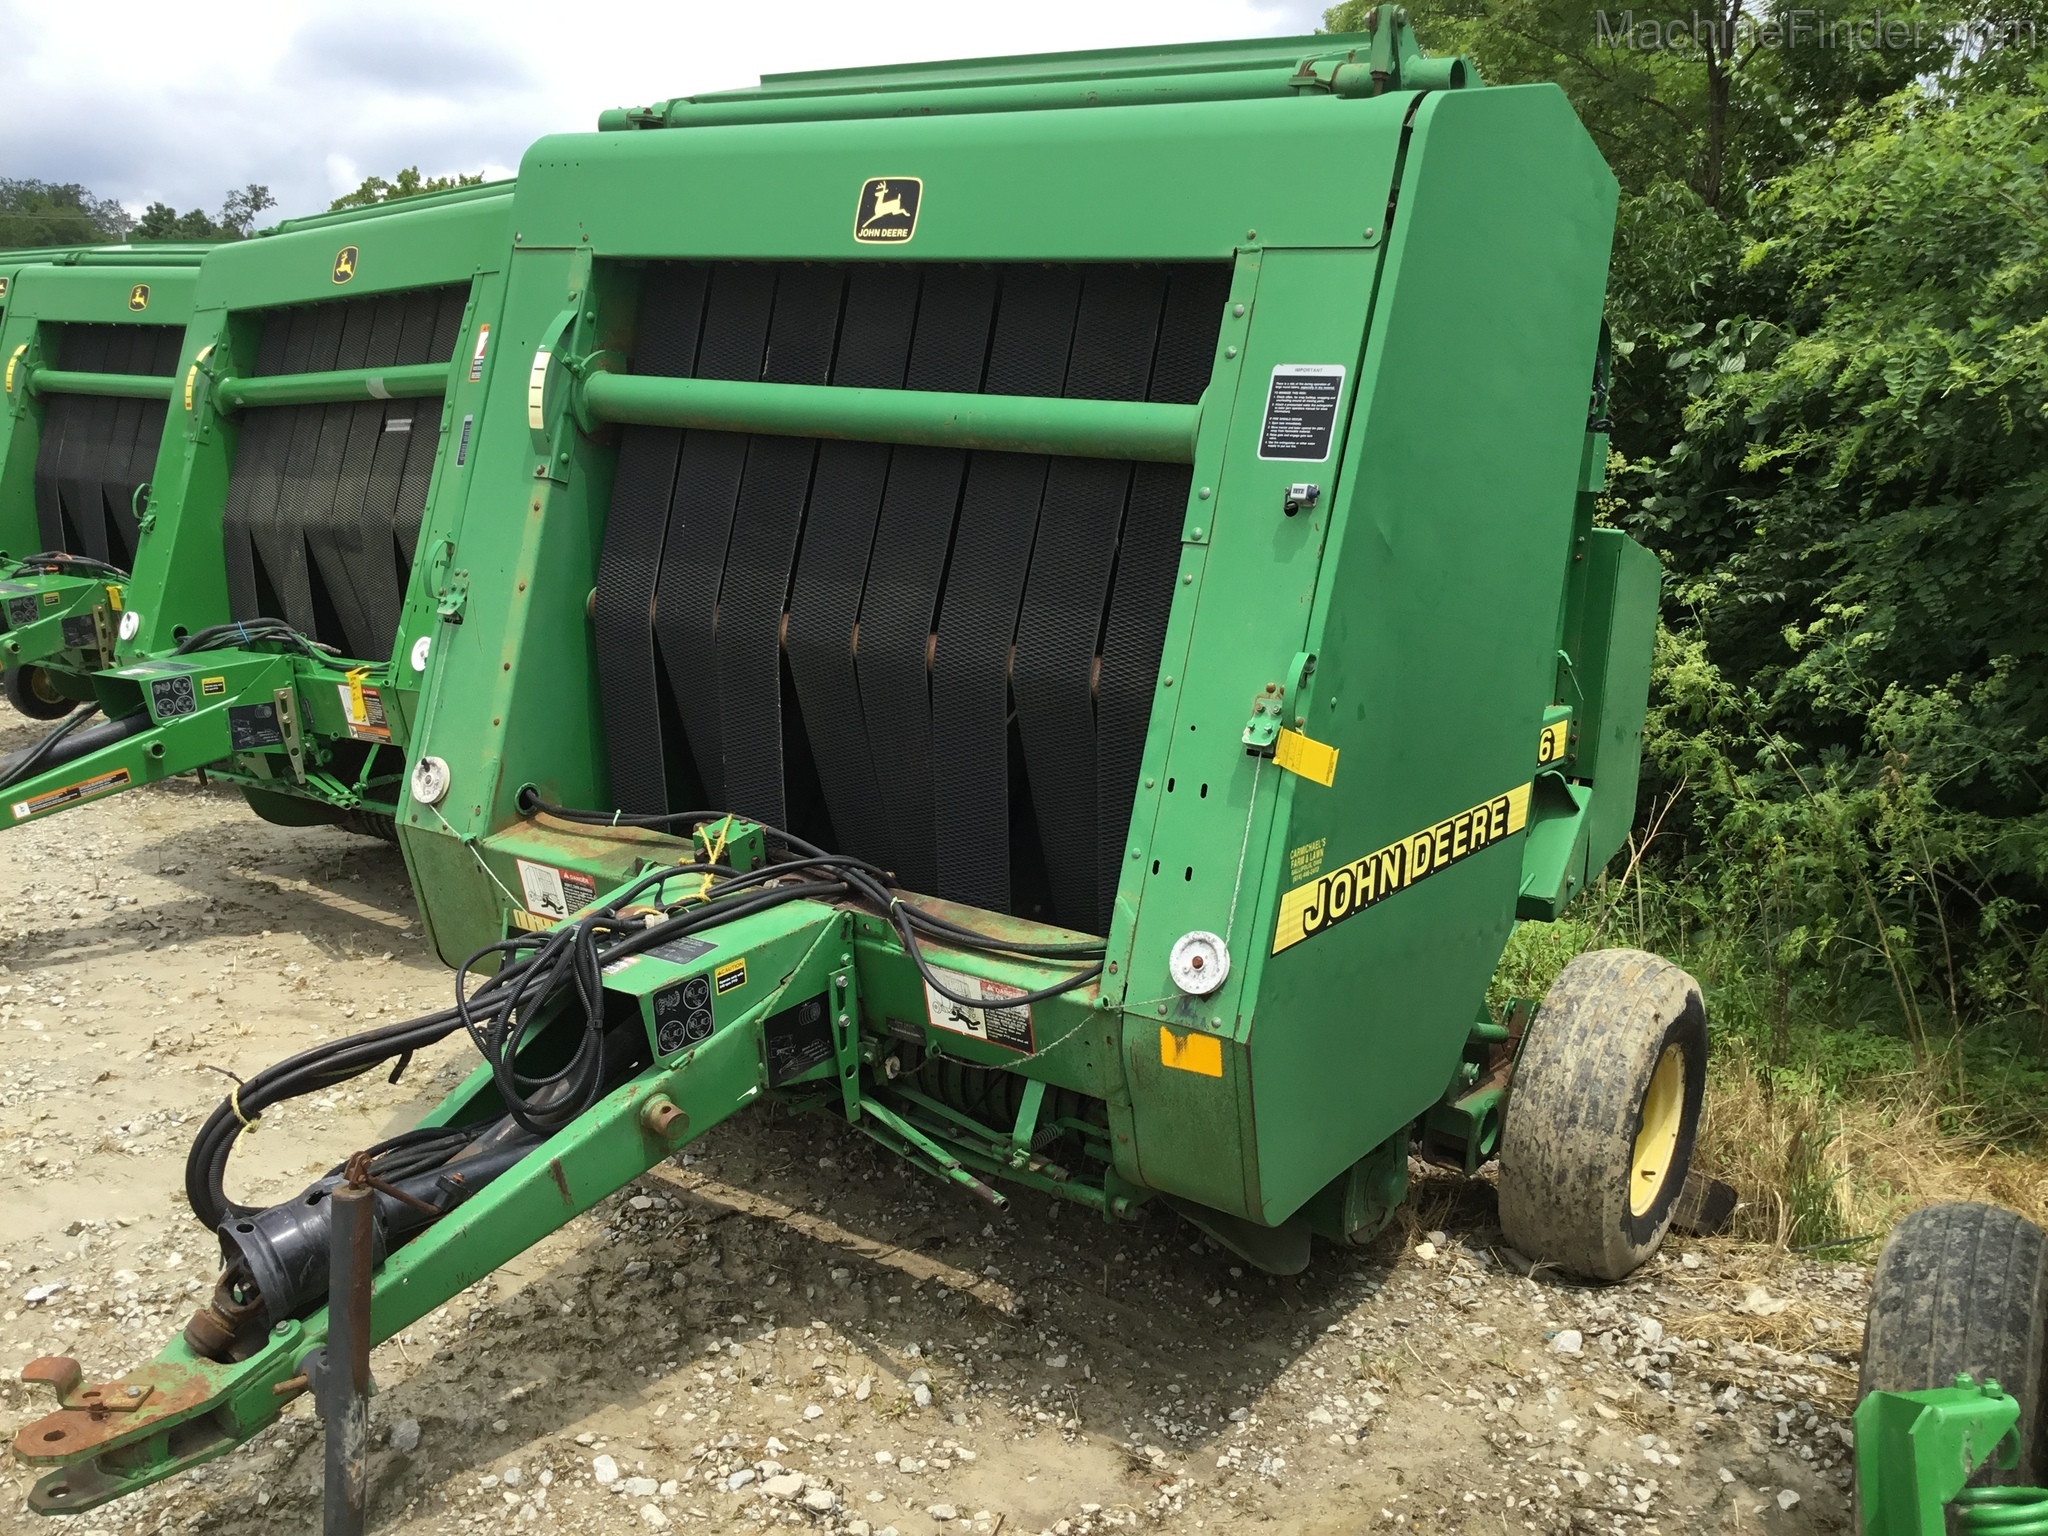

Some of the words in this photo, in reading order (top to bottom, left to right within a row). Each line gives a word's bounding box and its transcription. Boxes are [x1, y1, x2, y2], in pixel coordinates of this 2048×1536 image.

[858, 228, 881, 238] JOHN
[881, 228, 909, 238] DEERE
[1291, 855, 1305, 869] FARM
[1303, 845, 1405, 933] JOHN
[1410, 797, 1510, 880] DEERE
[721, 961, 744, 974] CAUTION
